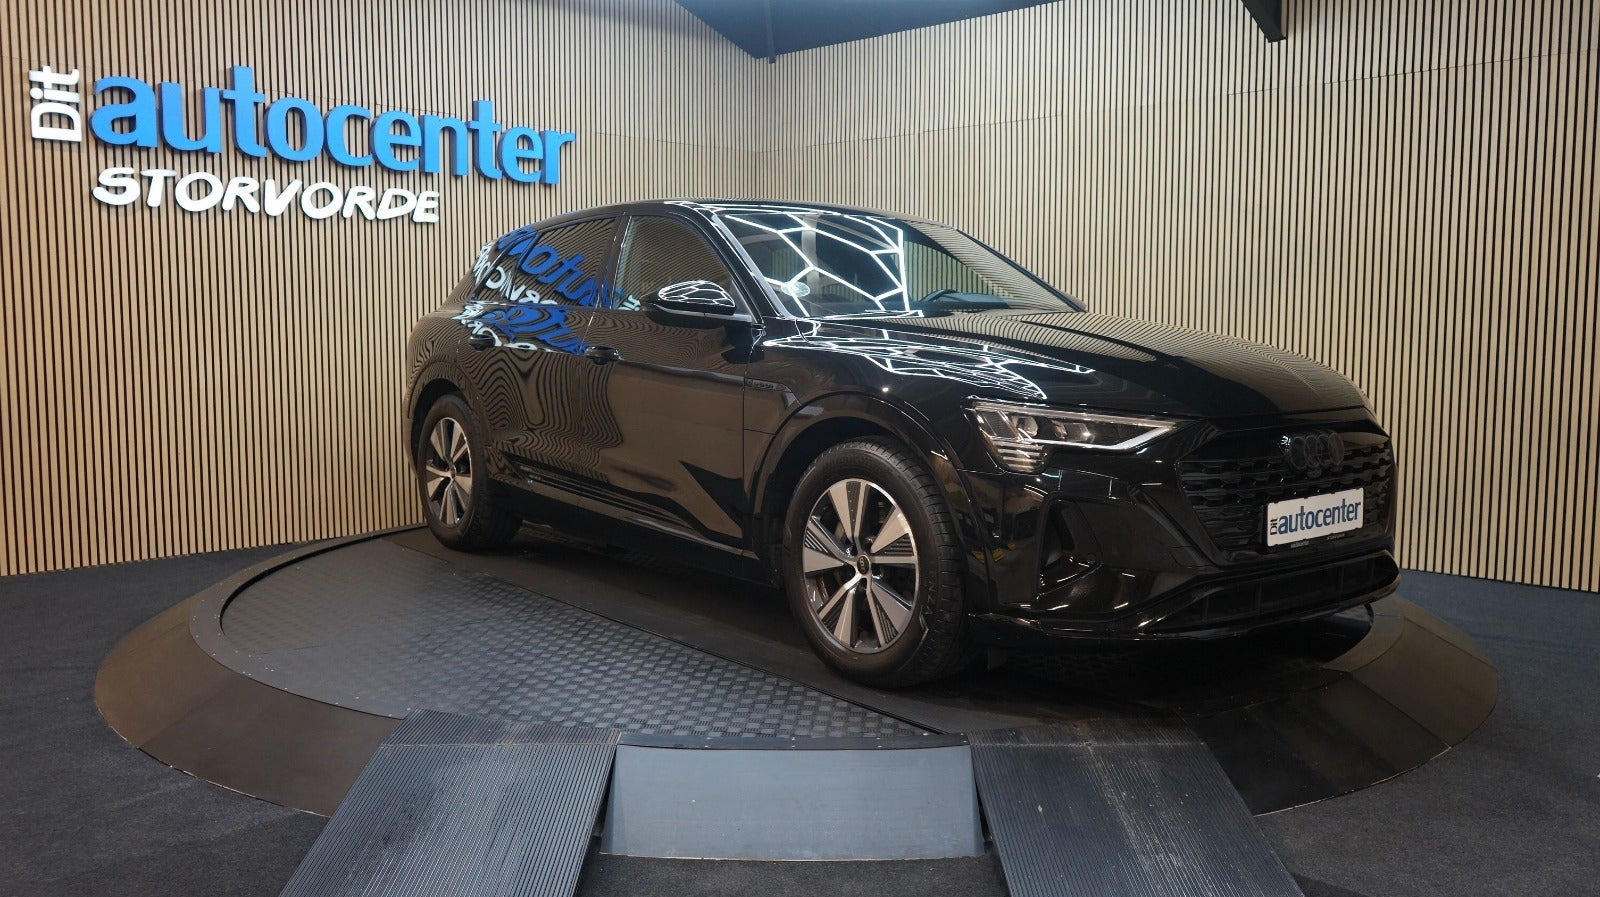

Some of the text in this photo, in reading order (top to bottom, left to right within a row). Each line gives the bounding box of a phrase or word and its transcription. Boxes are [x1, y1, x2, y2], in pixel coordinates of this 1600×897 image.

[29, 65, 576, 185] Dit autocenter
[92, 167, 440, 223] STORVORDE
[1269, 498, 1362, 536] Dit autocenter
